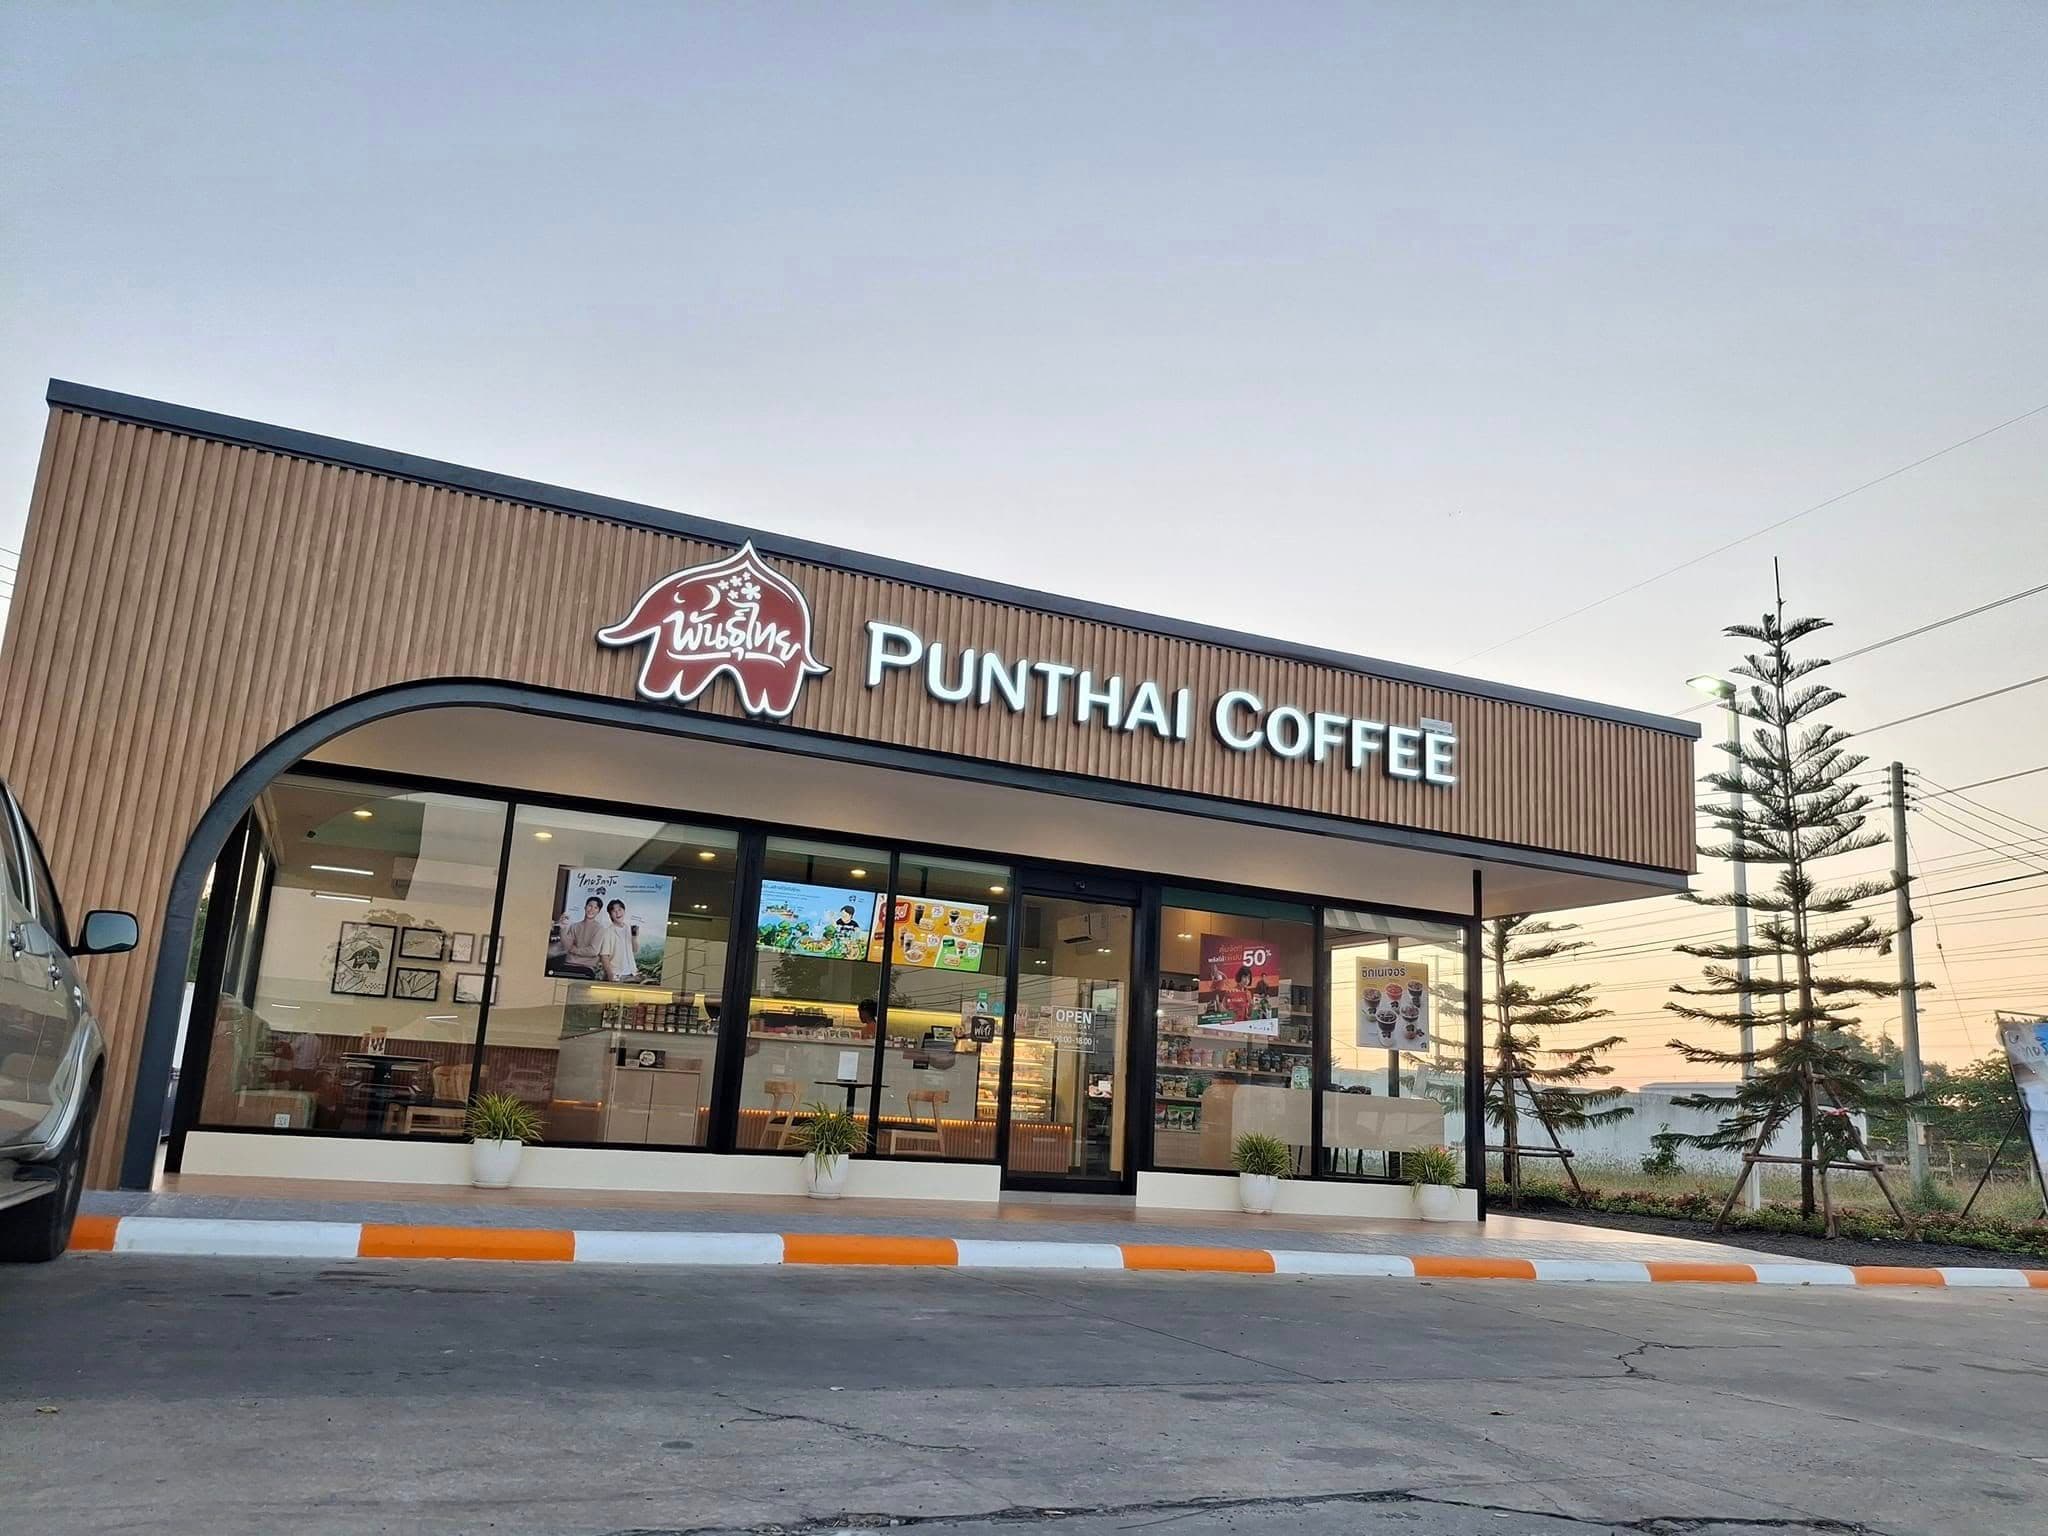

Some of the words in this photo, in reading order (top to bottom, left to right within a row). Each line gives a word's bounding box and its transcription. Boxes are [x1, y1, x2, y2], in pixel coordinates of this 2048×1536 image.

[867, 621, 1189, 741] PUNTHAI
[1214, 690, 1459, 785] COFFEE
[1361, 964, 1406, 978] ซิกเนเจอร์
[1056, 1009, 1092, 1025] OPEN
